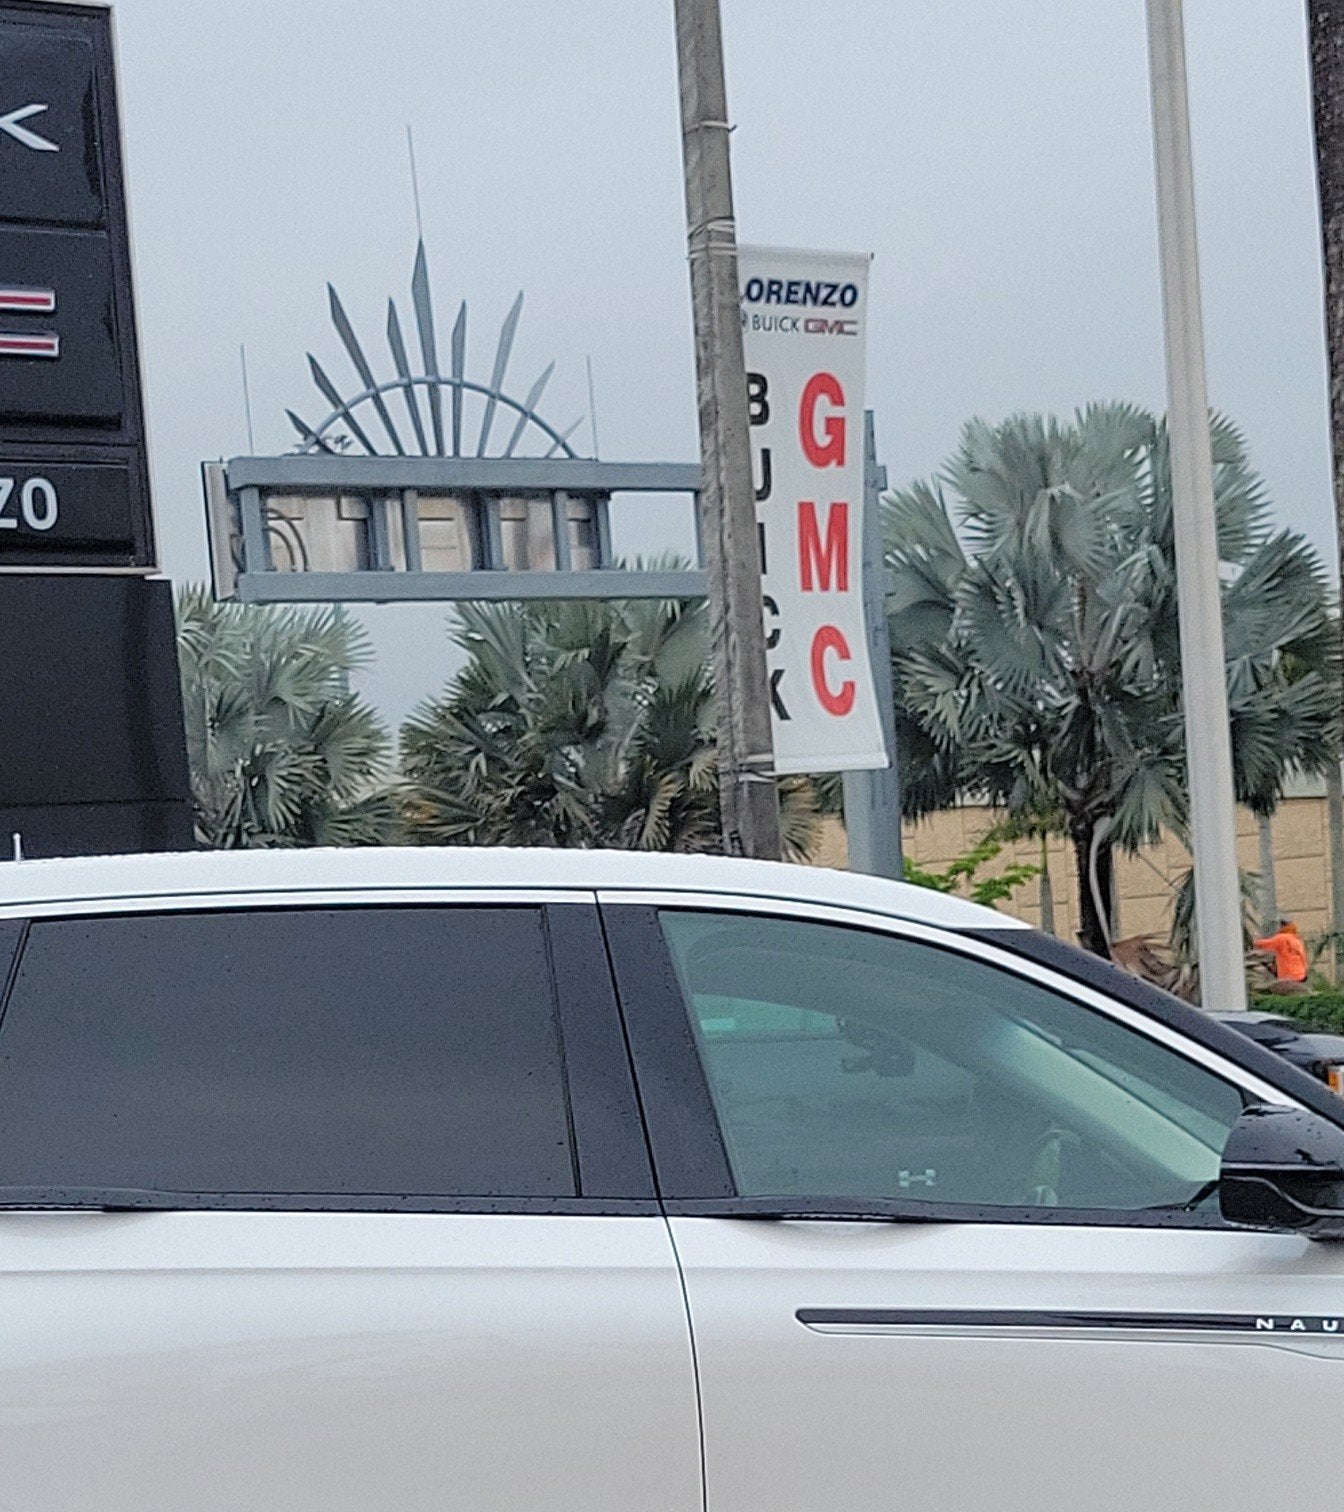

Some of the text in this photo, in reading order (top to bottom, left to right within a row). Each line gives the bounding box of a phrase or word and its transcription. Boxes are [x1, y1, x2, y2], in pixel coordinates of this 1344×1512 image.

[742, 279, 858, 308] ORENZO
[752, 314, 858, 335] BUICK GMC
[798, 372, 855, 716] GMC
